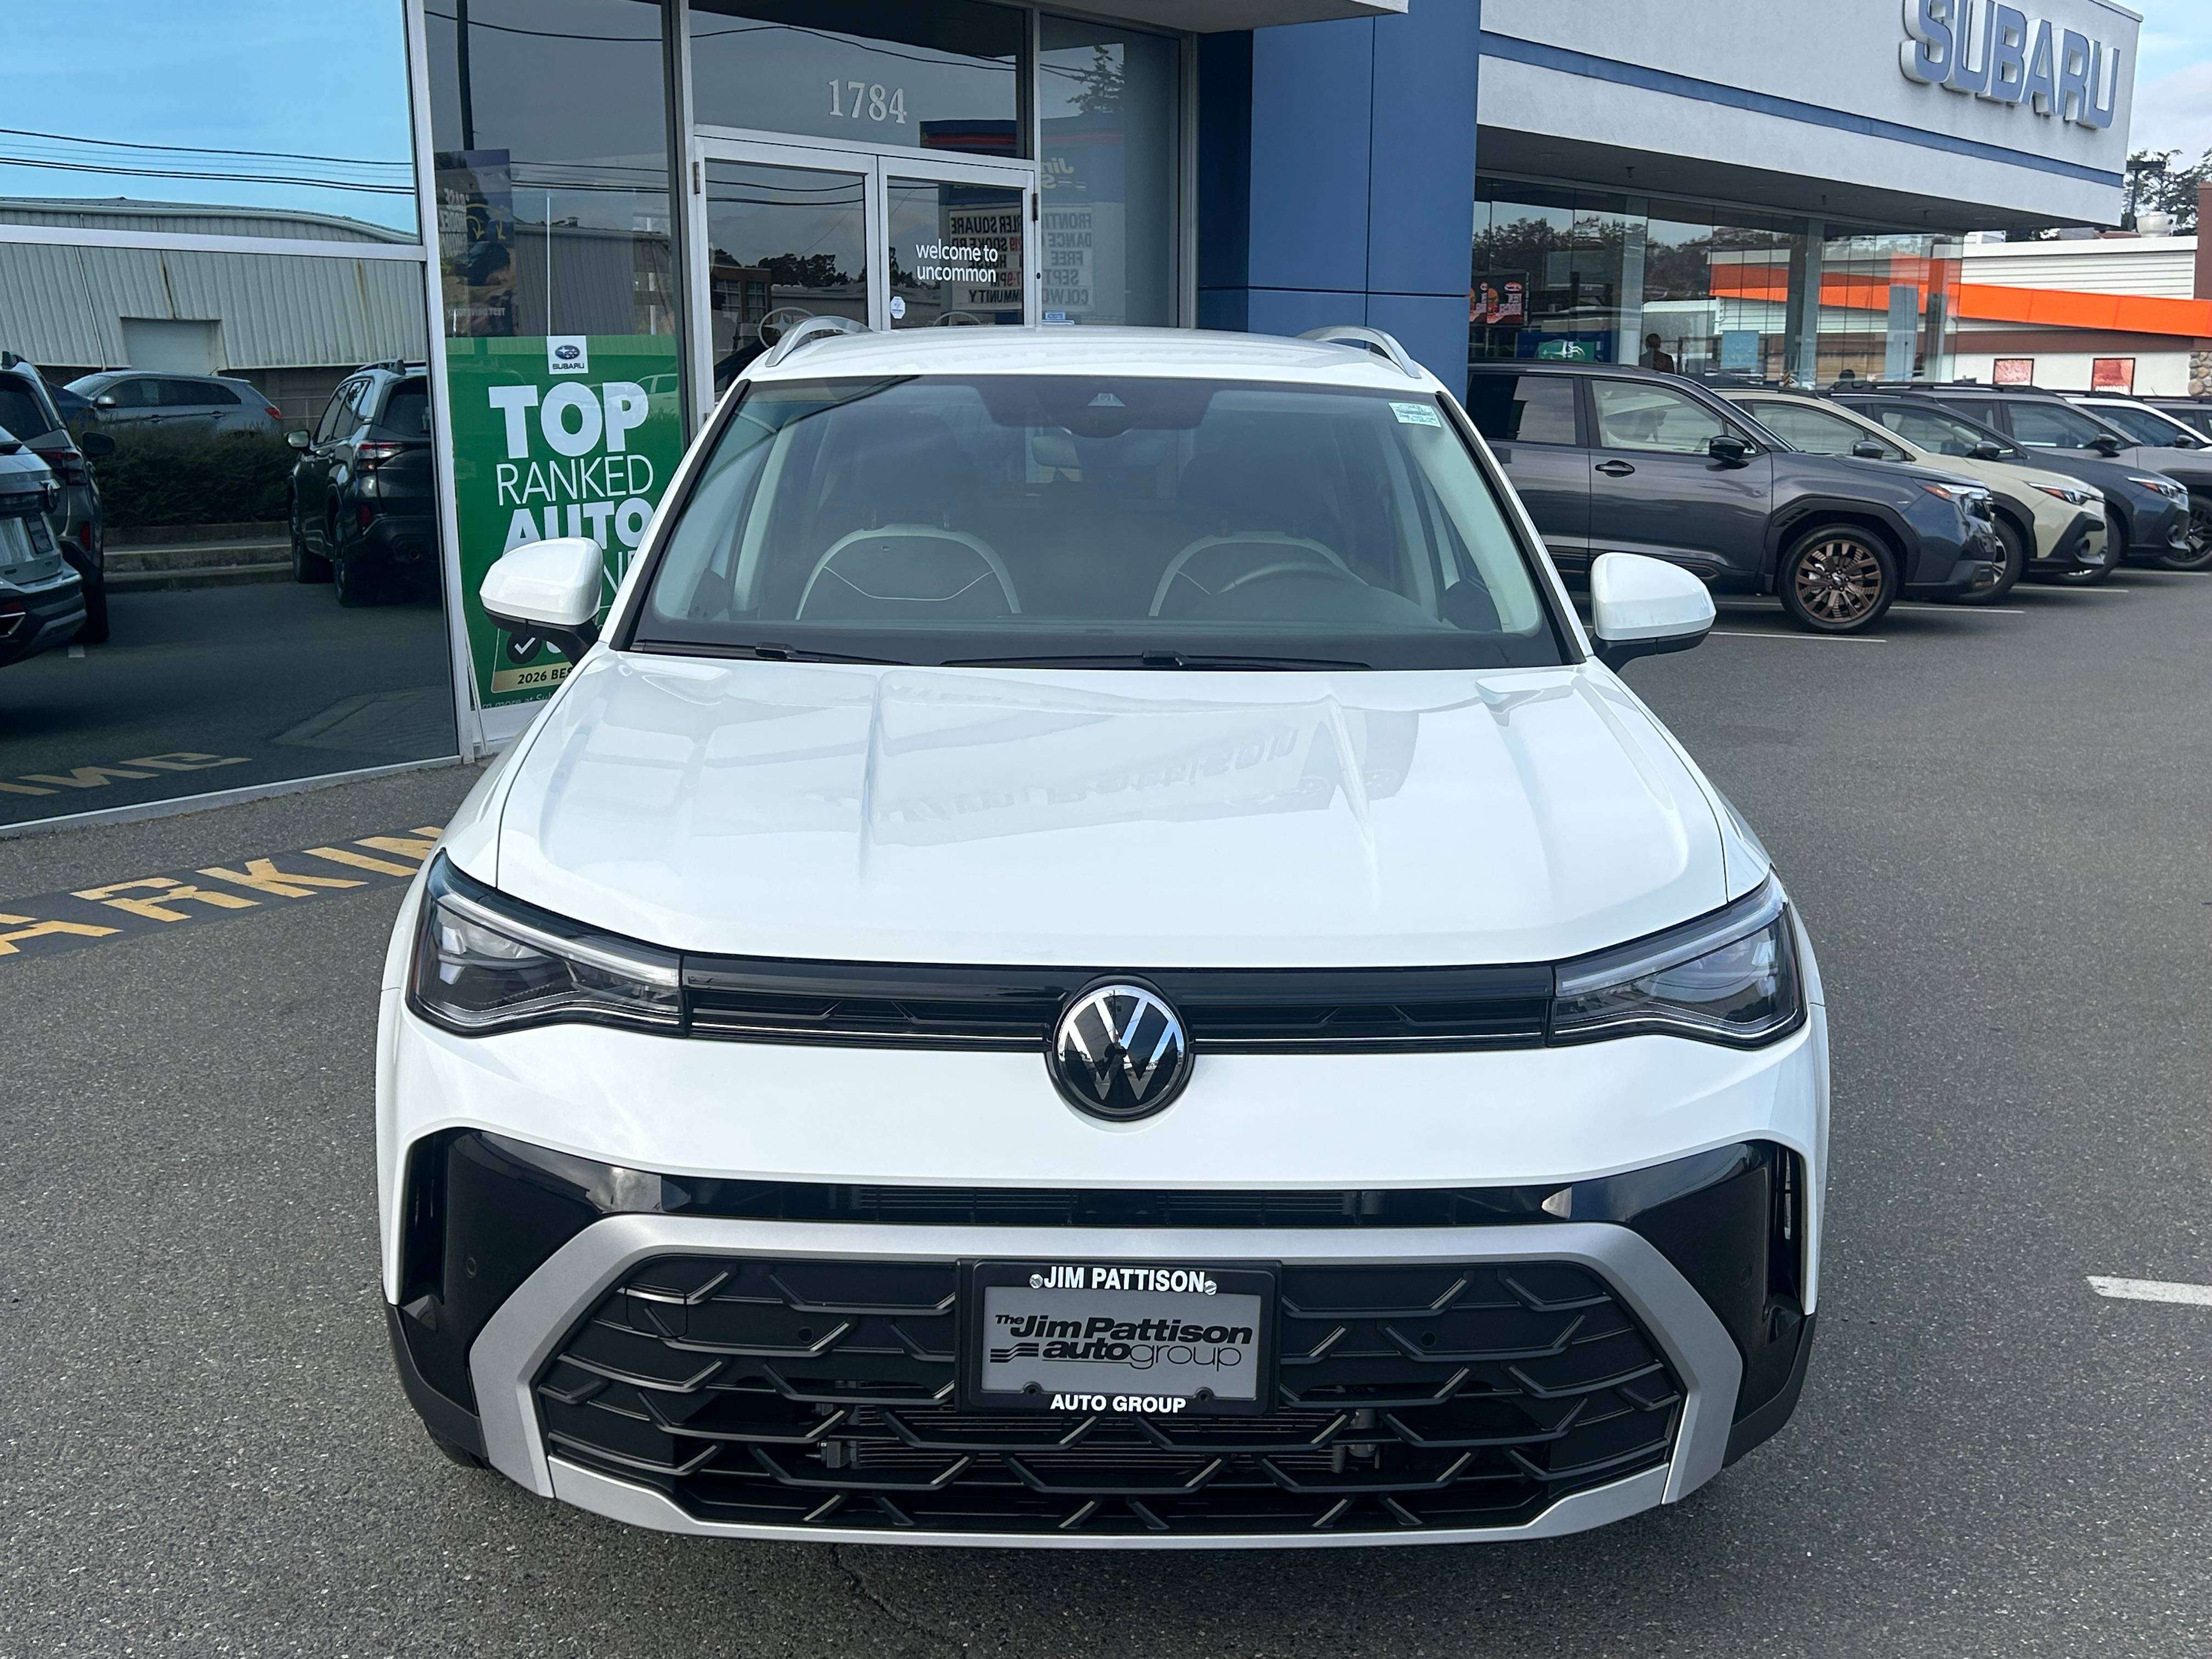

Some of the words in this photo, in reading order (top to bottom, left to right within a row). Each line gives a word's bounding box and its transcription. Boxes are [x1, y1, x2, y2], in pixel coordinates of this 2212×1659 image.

[1901, 0, 2121, 129] SUBARU
[828, 78, 907, 123] 1784
[916, 239, 981, 262] welcome
[984, 245, 998, 262] to
[917, 265, 996, 283] uncommon
[488, 381, 649, 459] TOP
[496, 454, 653, 506] RANKED
[503, 497, 654, 558] AUTO
[517, 670, 547, 685] 2026
[551, 667, 573, 680] BES
[1043, 1266, 1084, 1289] JIM
[1091, 1267, 1205, 1293] PATTISON
[995, 1314, 1024, 1325] The
[1050, 1394, 1107, 1411] AUTO
[1112, 1396, 1186, 1413] GROUP
